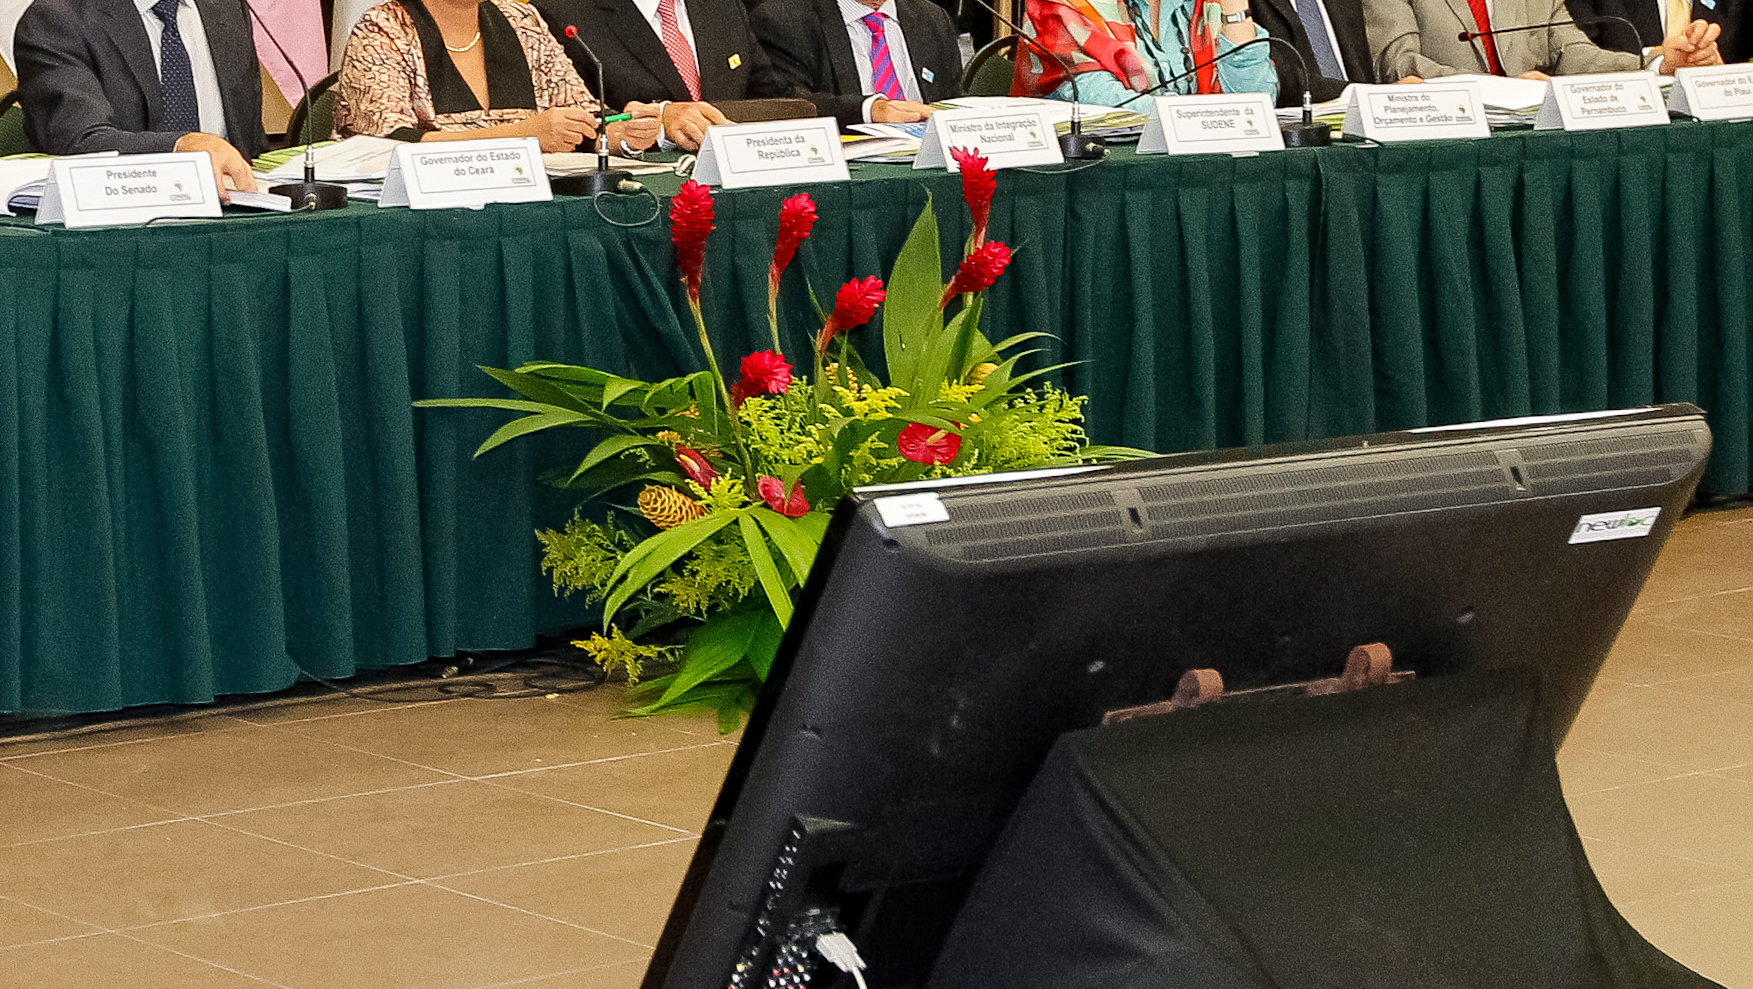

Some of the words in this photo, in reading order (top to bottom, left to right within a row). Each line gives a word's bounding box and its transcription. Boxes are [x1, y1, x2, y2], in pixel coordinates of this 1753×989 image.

[1245, 107, 1254, 115] da
[1201, 119, 1236, 129] SUDENE
[1426, 114, 1454, 123] Gestão
[949, 121, 982, 133] Ministro
[984, 121, 995, 131] da
[996, 118, 1037, 131] Integração
[745, 136, 792, 147] Presidenta
[794, 134, 806, 143] da
[979, 133, 1015, 144] Nacional
[420, 154, 474, 166] Governador
[476, 152, 488, 162] do
[489, 151, 521, 161] Estado
[757, 149, 801, 160] República
[106, 168, 158, 180] Presidente
[454, 167, 466, 176] do
[467, 165, 495, 175] Ceará
[105, 186, 120, 196] Do
[121, 184, 157, 195] Senado
